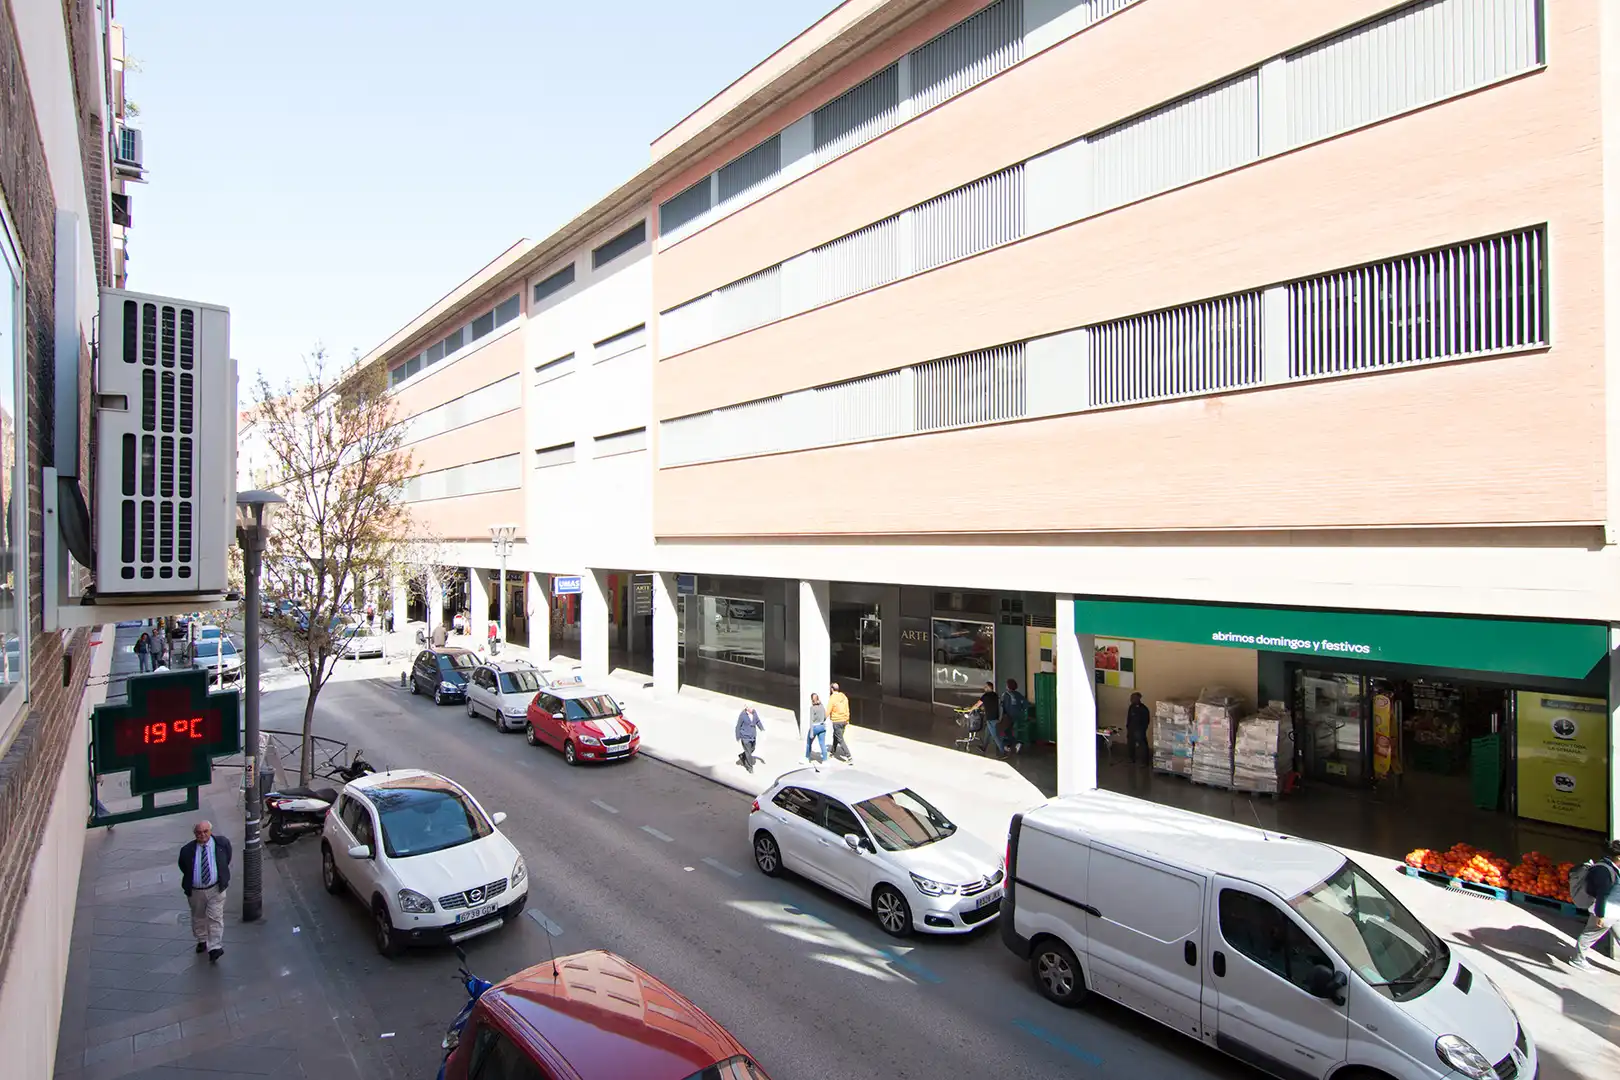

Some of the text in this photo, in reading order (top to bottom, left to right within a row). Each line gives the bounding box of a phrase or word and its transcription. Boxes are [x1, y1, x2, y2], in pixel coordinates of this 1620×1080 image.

[901, 630, 929, 642] ARTE
[1212, 631, 1370, 654] abrimos domingos y festivos
[144, 723, 167, 744] 19
